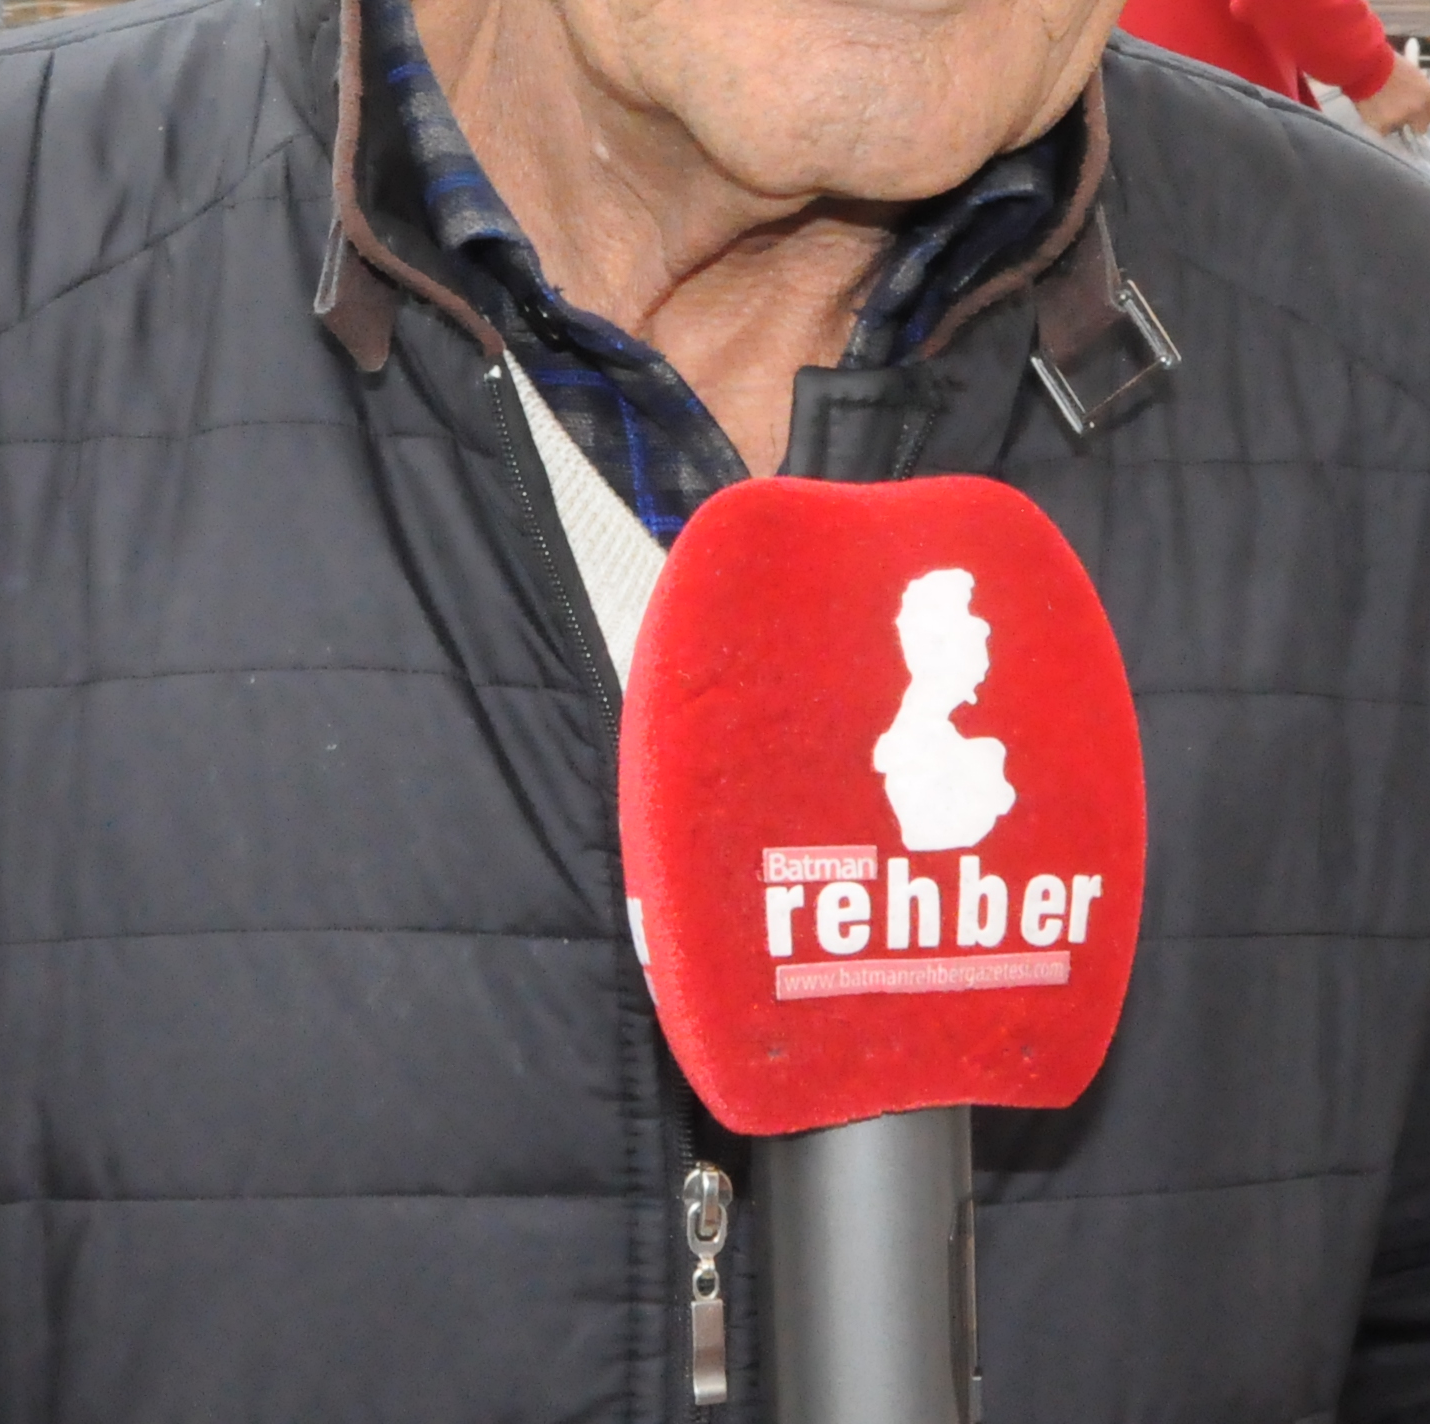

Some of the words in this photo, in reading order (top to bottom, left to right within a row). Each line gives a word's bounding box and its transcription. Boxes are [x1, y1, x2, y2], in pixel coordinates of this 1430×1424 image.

[770, 852, 871, 880] Batman
[765, 855, 1103, 958] rehber
[783, 960, 1064, 992] www.batmanrehbergazetesi.com
